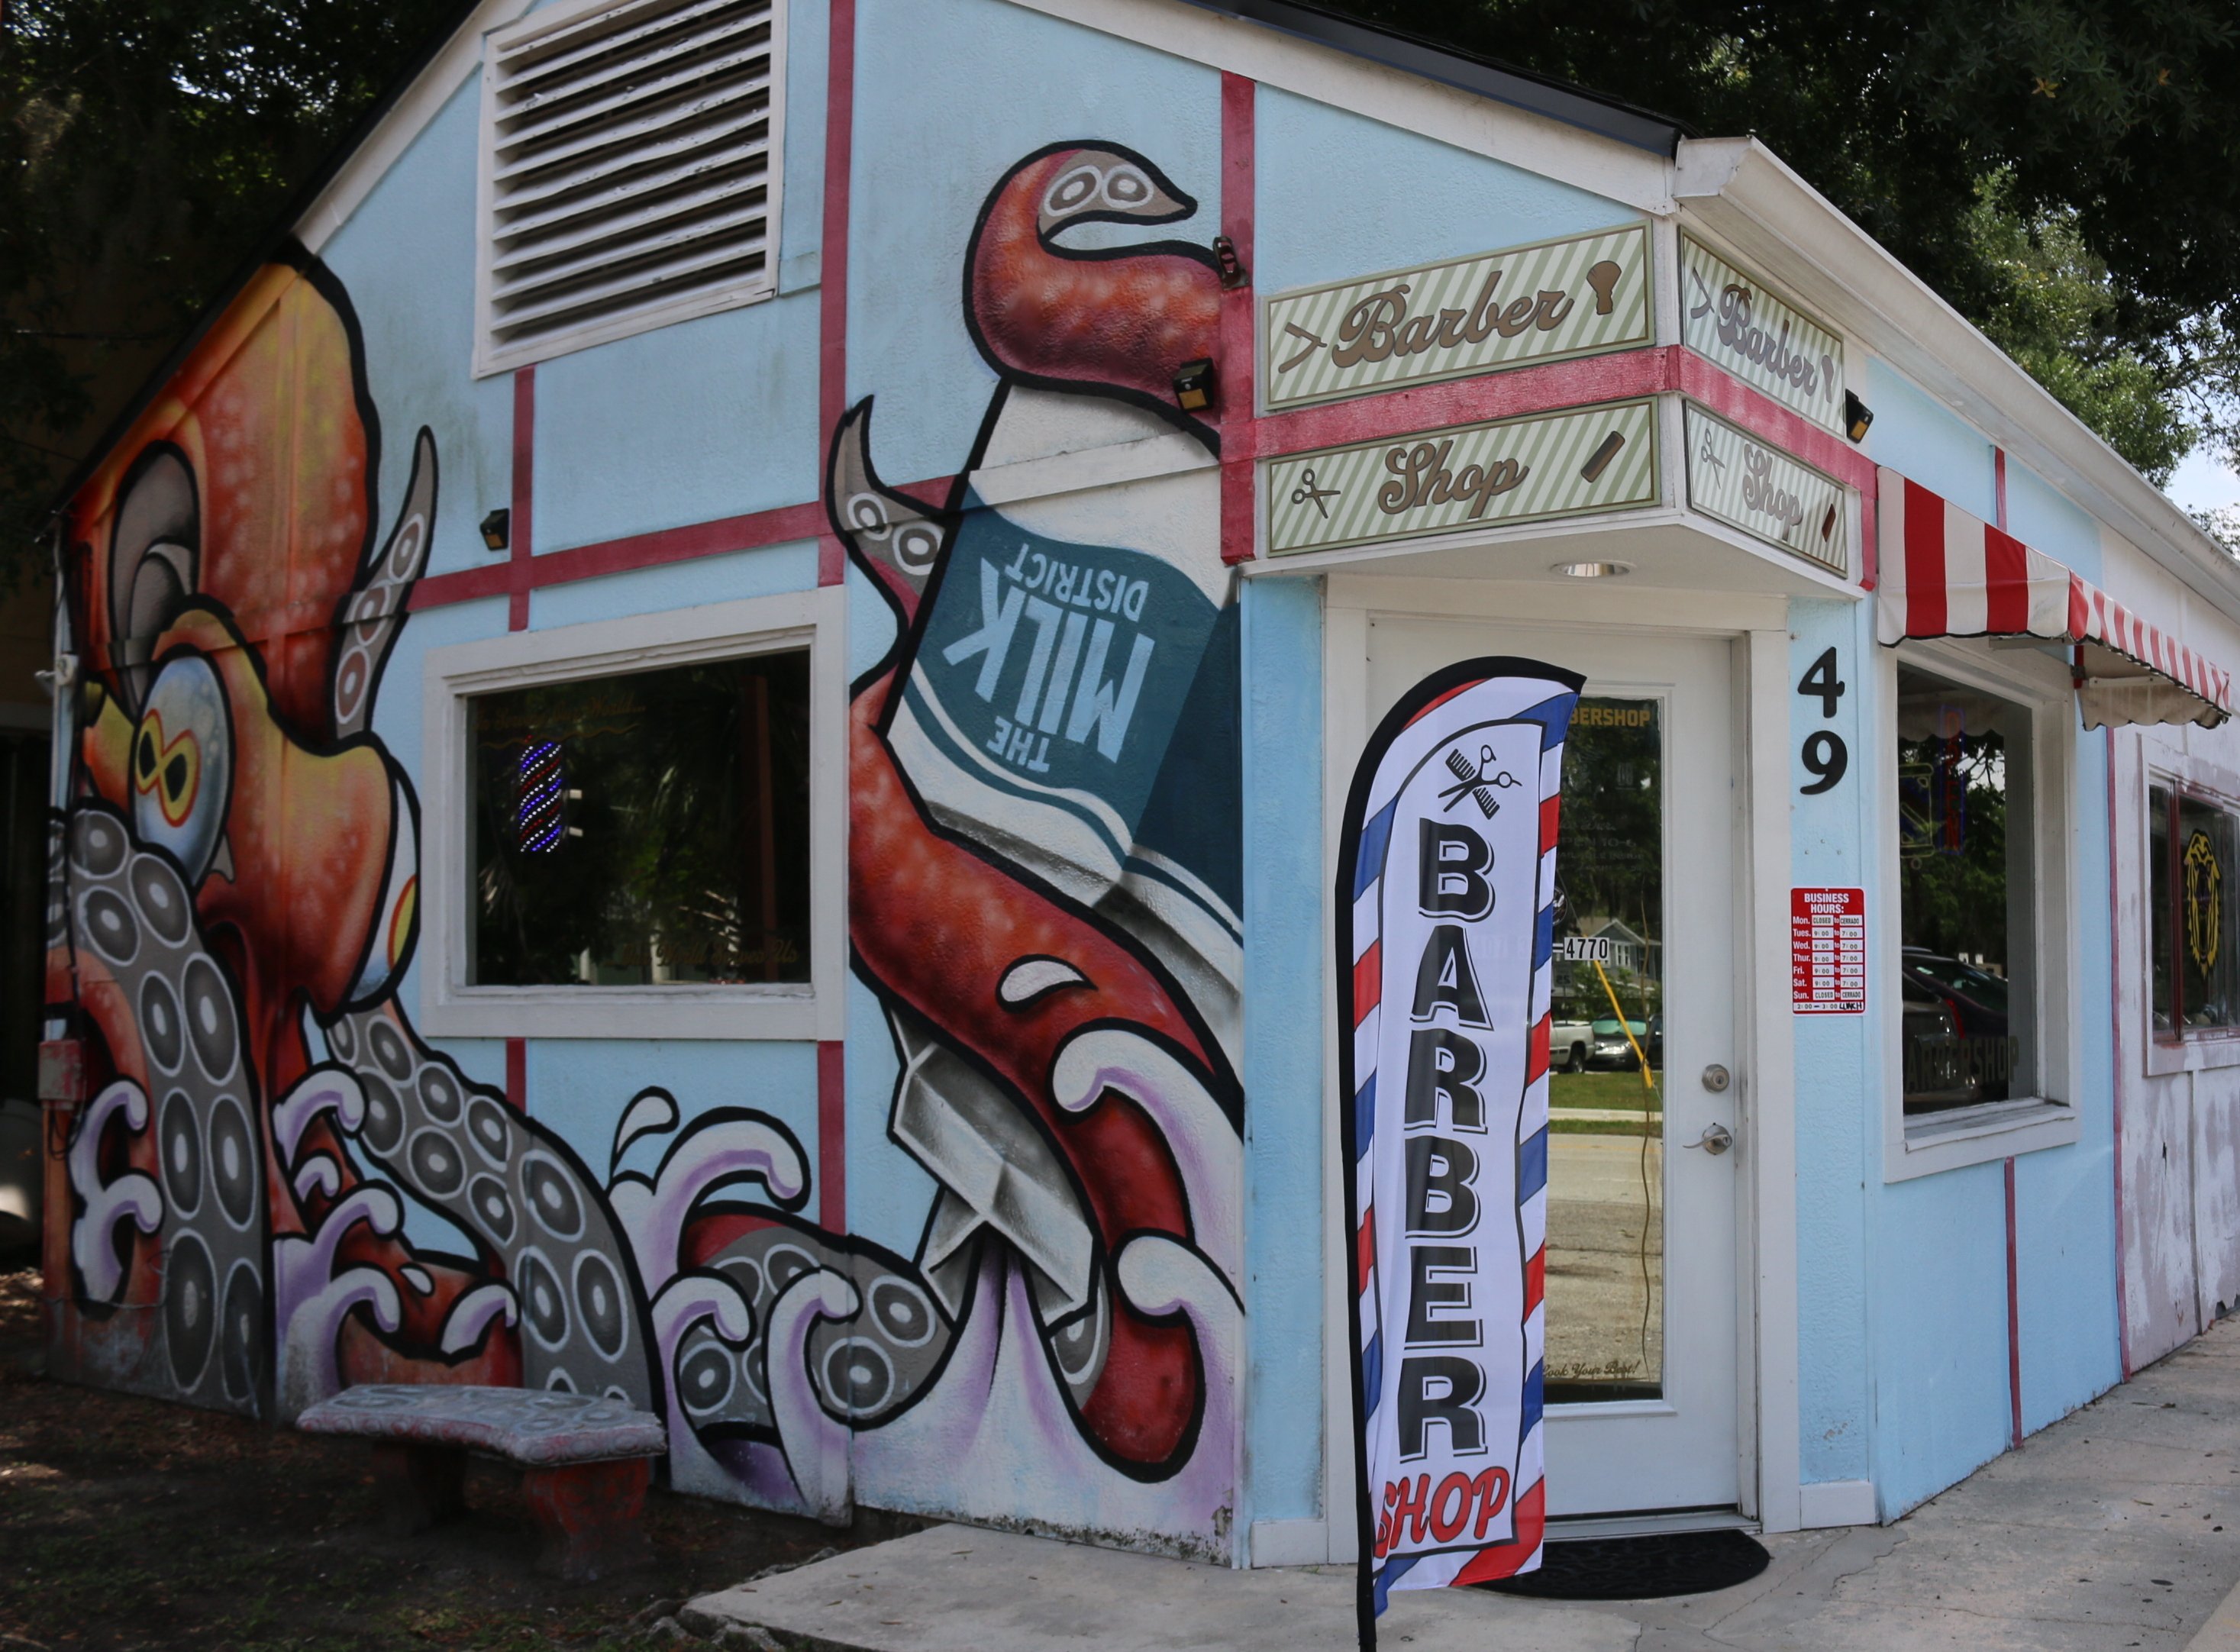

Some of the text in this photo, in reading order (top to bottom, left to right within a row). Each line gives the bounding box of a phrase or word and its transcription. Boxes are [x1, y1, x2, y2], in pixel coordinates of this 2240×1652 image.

[1331, 270, 1575, 368] Barber
[1718, 283, 1818, 396] Barber
[1377, 440, 1529, 519] Shop
[1742, 443, 1803, 540] Shop
[1005, 543, 1149, 622] DISTRICT
[942, 557, 1155, 763] MILK
[986, 715, 1050, 772] THE
[1797, 647, 1848, 795] 49
[1793, 916, 1810, 924] Mon.
[1804, 893, 1849, 902] BUSINESS
[1811, 904, 1844, 913] HOURS:
[1793, 991, 1809, 999] Sun.
[1399, 817, 1496, 1463] BARBER
[1572, 1363, 1600, 1379] Your
[1373, 1466, 1510, 1558] SHOP
